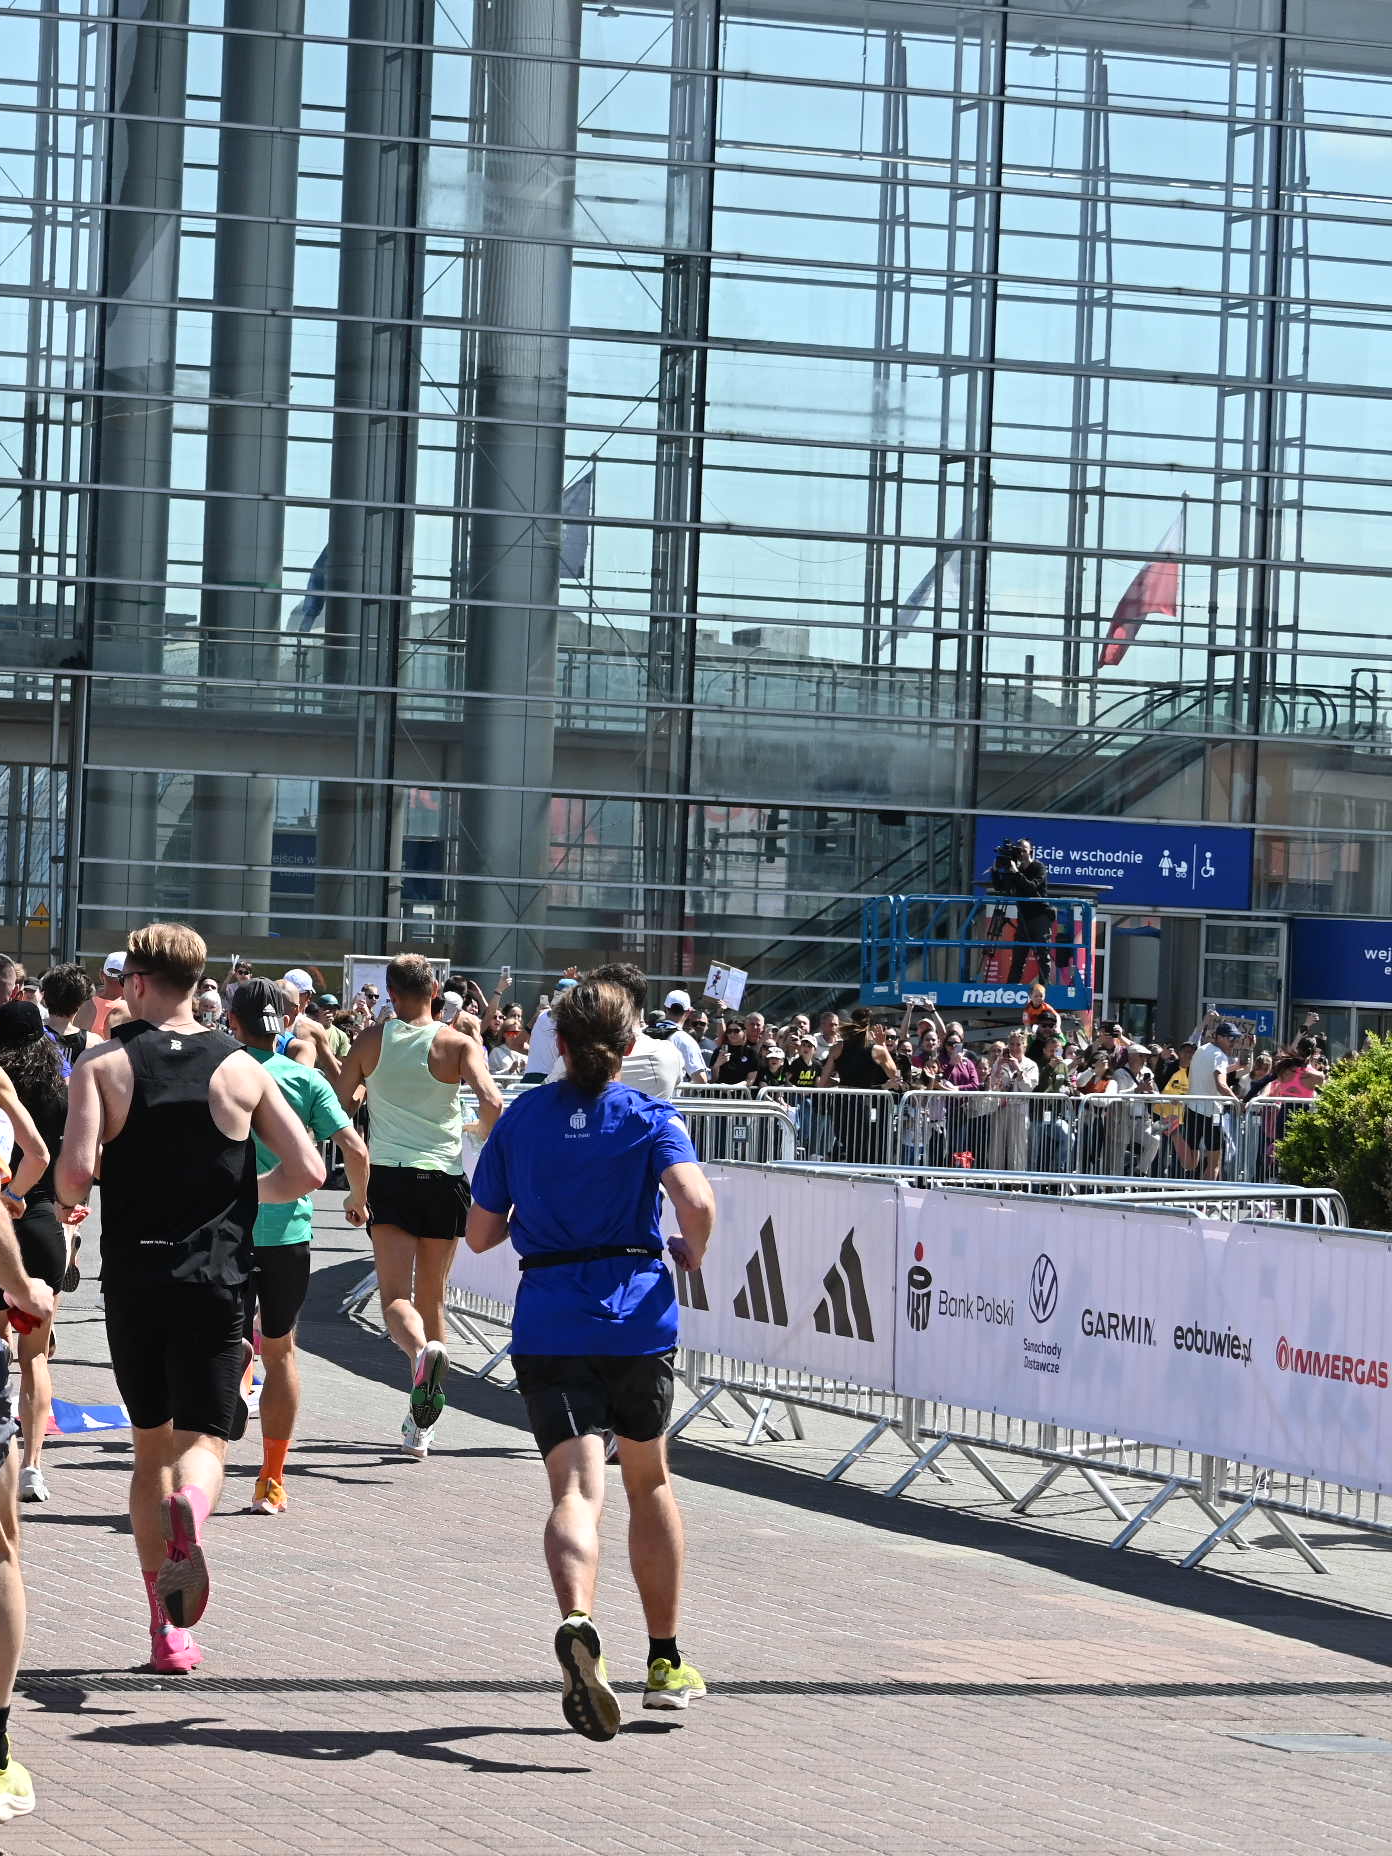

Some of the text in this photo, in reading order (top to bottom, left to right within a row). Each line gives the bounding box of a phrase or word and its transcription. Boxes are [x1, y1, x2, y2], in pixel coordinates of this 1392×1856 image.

[1031, 845, 1143, 864] jście wschodnie
[1075, 865, 1125, 878] entrance
[962, 987, 1031, 1005] matec
[938, 1289, 1014, 1326] Bank Polski
[1081, 1308, 1156, 1346] GARMIN
[1023, 1338, 1062, 1359] Samochody
[1173, 1321, 1252, 1367] eobuwie.pl
[1023, 1355, 1060, 1373] Dostawcze
[1289, 1346, 1388, 1389] IMMERGAS
